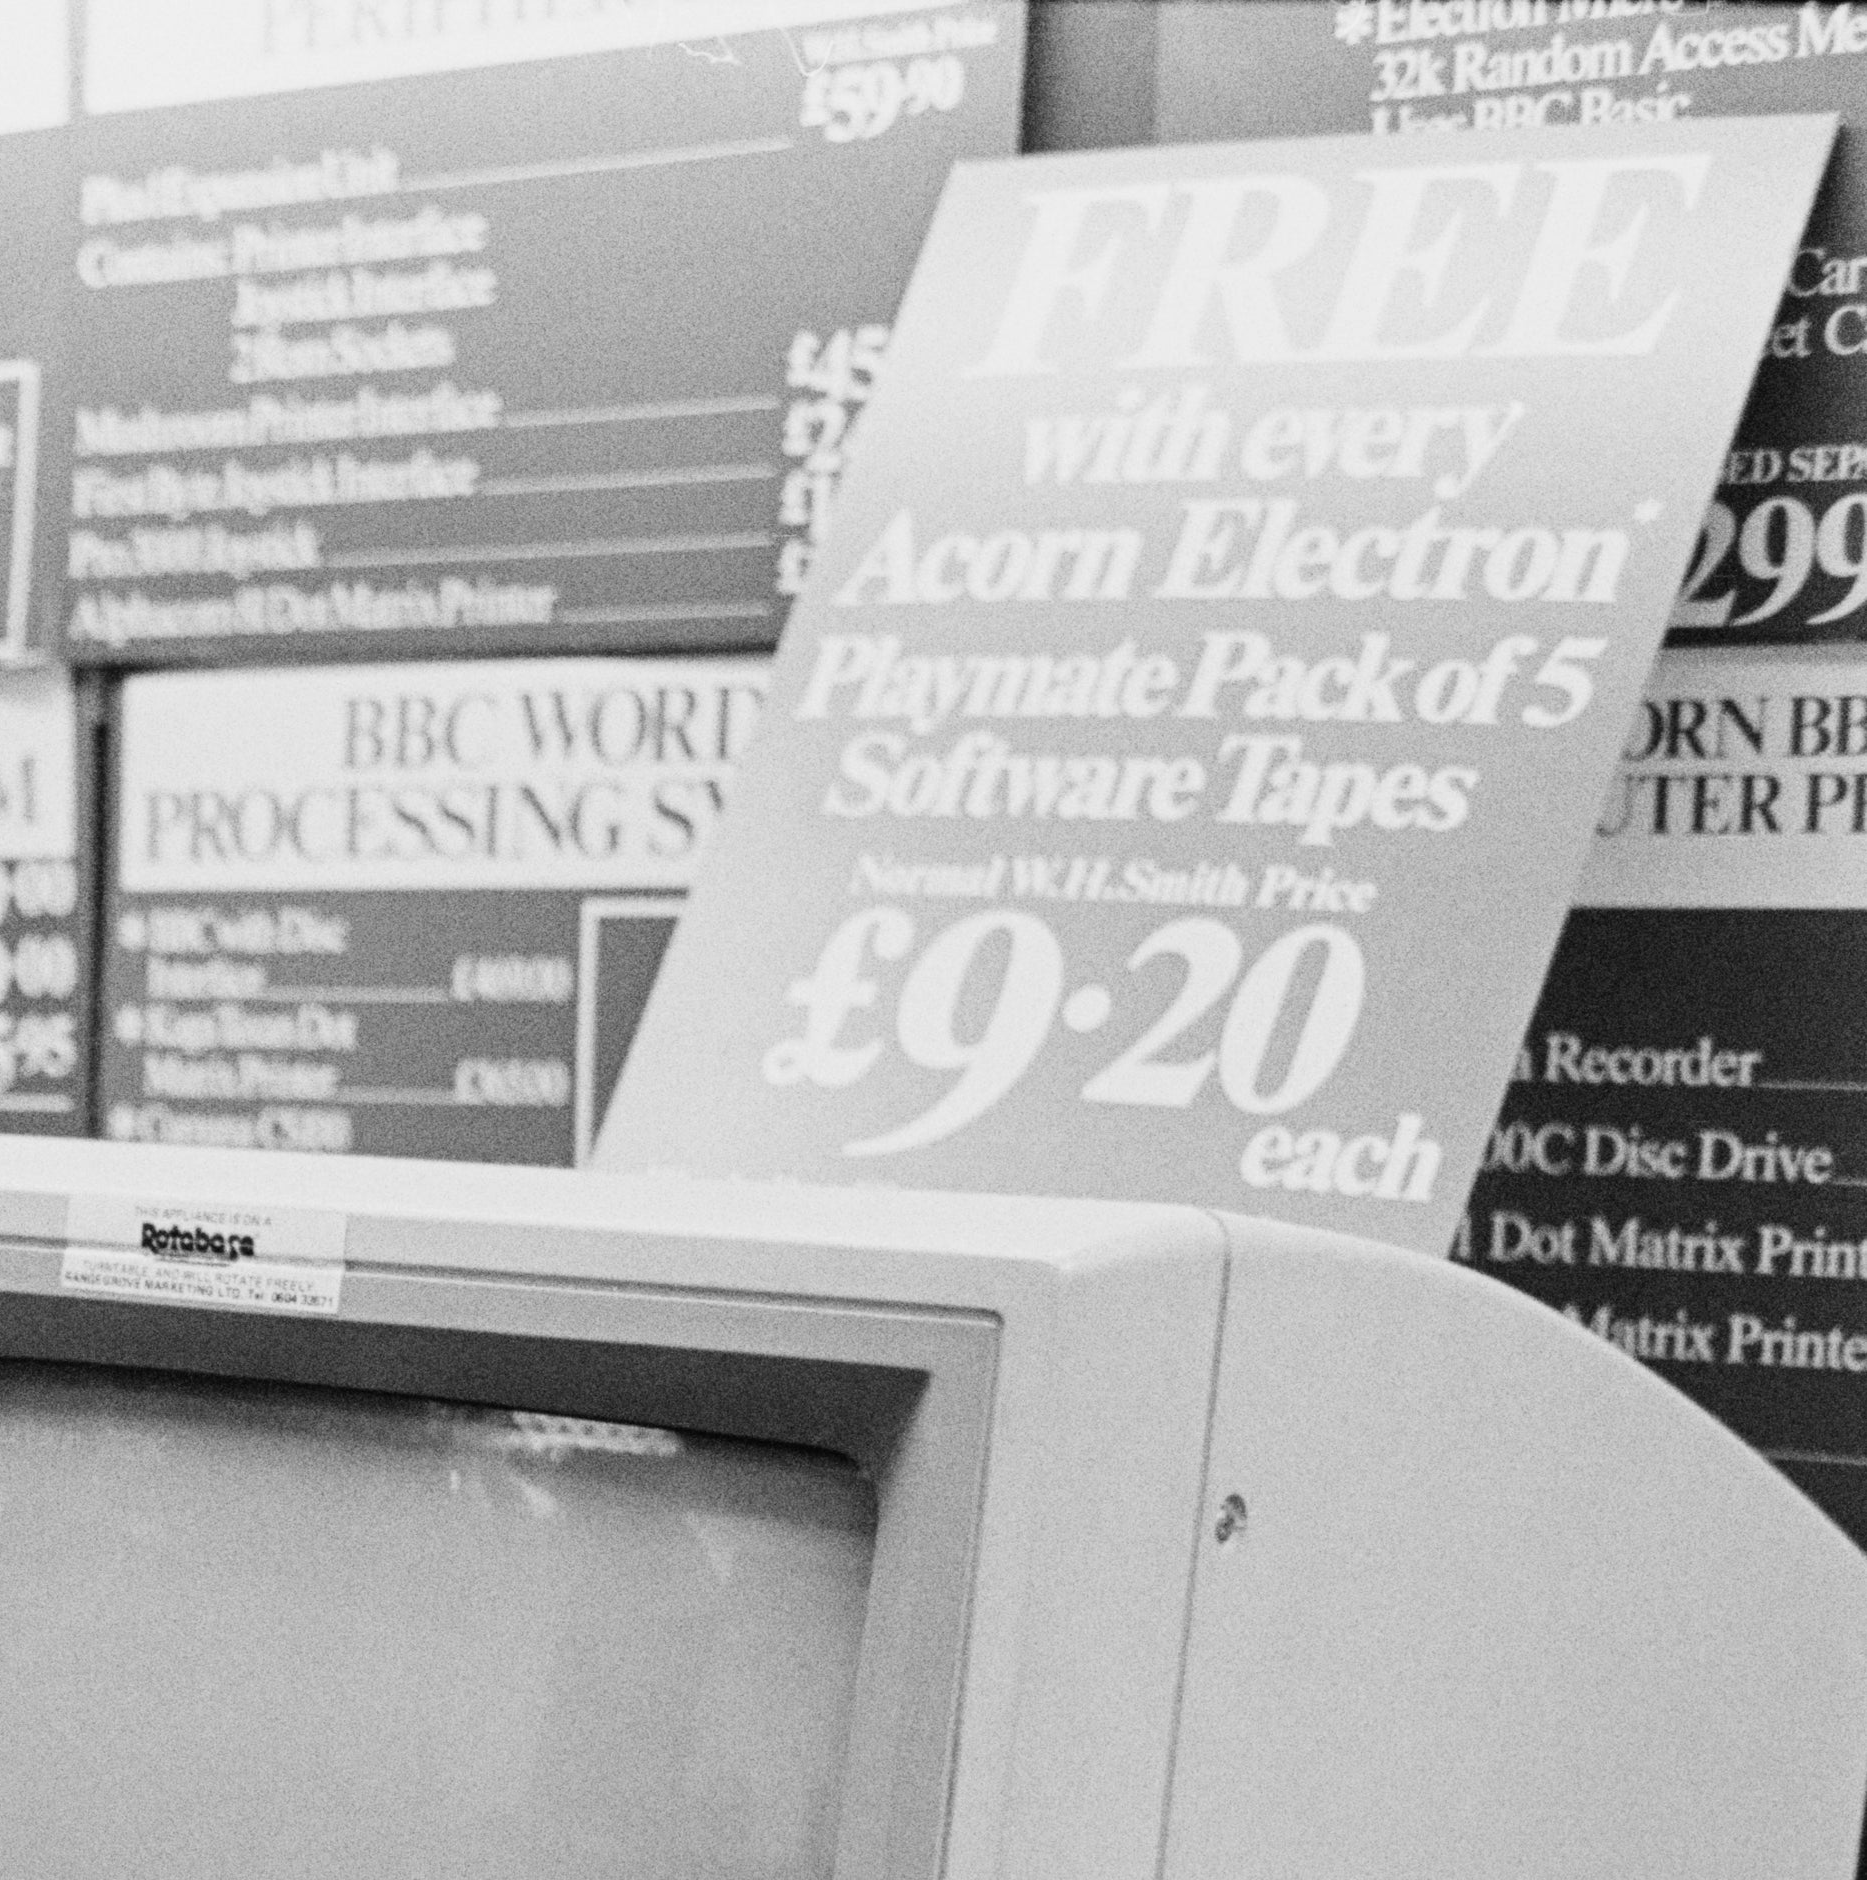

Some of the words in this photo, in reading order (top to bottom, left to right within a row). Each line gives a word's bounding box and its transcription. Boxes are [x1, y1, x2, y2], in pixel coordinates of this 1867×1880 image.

[1369, 48, 1447, 104] 32k
[1453, 32, 1633, 96] Random
[1639, 18, 1792, 77] Access
[950, 152, 1715, 382] FREE
[1021, 384, 1228, 486] with
[1241, 402, 1525, 499] every
[833, 510, 1143, 608] Acorn
[795, 632, 1181, 734] Playmate
[1183, 628, 1409, 729] Pack
[1415, 638, 1529, 734] of
[1525, 634, 1613, 733] 5
[338, 692, 499, 772] BBC
[143, 782, 627, 864] PROCESSING
[822, 730, 1208, 832] Software
[1215, 730, 1482, 850] Tapes
[848, 850, 1002, 900] Normal
[1255, 862, 1378, 916] Price
[1543, 1030, 1765, 1090] Recorder
[1236, 1110, 1445, 1206] each
[1583, 1120, 1689, 1182] Disc
[1692, 1127, 1835, 1189] Drive
[1488, 1208, 1576, 1266] Dot
[1587, 1215, 1747, 1277] Matrix
